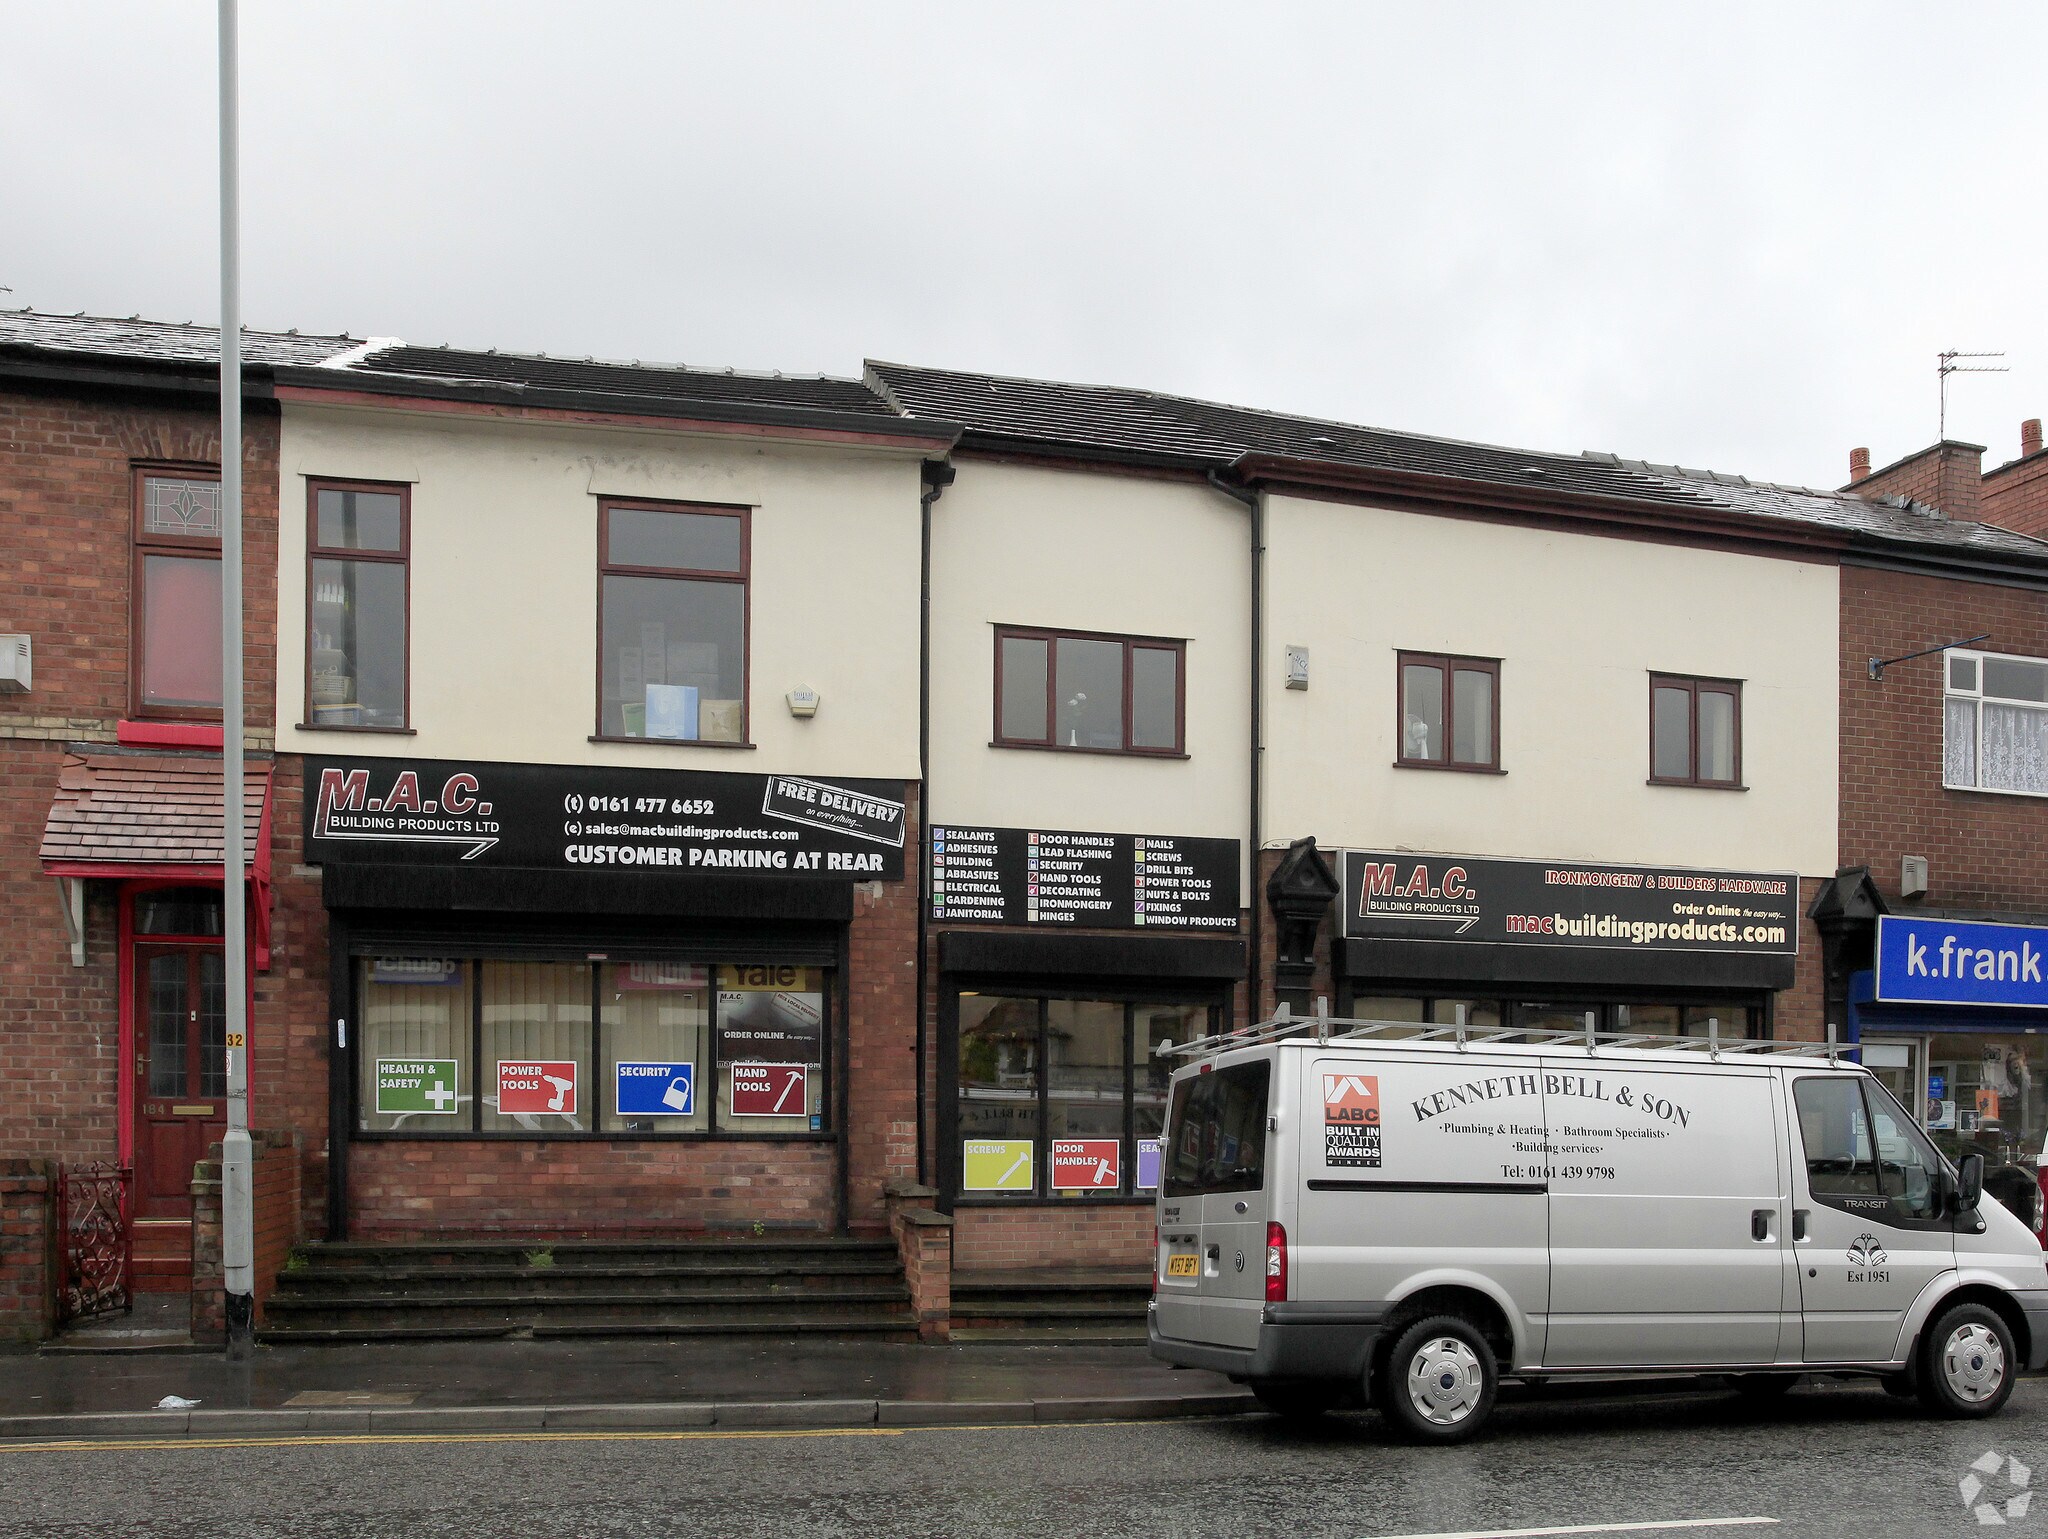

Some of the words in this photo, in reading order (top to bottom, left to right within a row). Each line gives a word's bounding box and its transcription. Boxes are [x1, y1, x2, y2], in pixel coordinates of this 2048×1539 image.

[313, 768, 493, 820] M.A.C.
[564, 793, 584, 814] (t)
[588, 796, 629, 812] 0161
[635, 798, 667, 813] 477
[671, 799, 714, 815] 6652
[777, 781, 817, 803] FREE
[820, 792, 899, 823] DELIVERY
[805, 808, 816, 816] on
[330, 816, 395, 830] BUILDING
[399, 818, 472, 832] PRODUCTS
[475, 821, 500, 834] LTD
[564, 822, 581, 836] (e)
[585, 823, 799, 841] sales@macbuildingproducts.com
[946, 830, 995, 842] SEALANTS
[1040, 835, 1069, 844] DOOR
[1071, 836, 1115, 846] HANDLES
[1146, 839, 1174, 849] NAILS
[946, 844, 998, 855] ADHESIVES
[1040, 847, 1064, 857] LEAD
[1066, 849, 1112, 859] FLASHING
[565, 845, 683, 866] CUSTOMER
[689, 848, 788, 869] PARKING
[793, 851, 822, 870] AT
[828, 852, 884, 872] REAR
[946, 857, 993, 867] BUILDING
[1146, 852, 1182, 862] SCREWS
[1040, 860, 1083, 870] SECURITY
[1146, 865, 1172, 875] DRILL
[1174, 866, 1194, 875] BITS
[946, 869, 999, 880] ABRASIVES
[1040, 873, 1068, 883] HAND
[1070, 875, 1101, 884] TOOLS
[946, 882, 1002, 893] ELECTRICAL
[1146, 878, 1179, 887] POWER
[1181, 879, 1212, 888] TOOLS
[1359, 863, 1476, 901] M.A.C.
[1545, 870, 1643, 888] IRONMONGERY
[1646, 875, 1656, 889] &
[1658, 876, 1716, 892] BUILDERS
[1719, 879, 1787, 895] HARDWARE
[1040, 886, 1101, 897] DECORATING
[1146, 890, 1170, 899] NUTS
[1172, 891, 1179, 899] &
[1181, 891, 1210, 901] BOLTS
[946, 895, 1005, 906] GARDENING
[1040, 899, 1112, 910] IRONMONGERY
[1146, 903, 1182, 913] FIXINGS
[1370, 901, 1412, 912] BUILDING
[1414, 902, 1462, 914] PRODUCTS
[1464, 904, 1480, 914] LTD
[1672, 902, 1704, 916] Order
[1707, 904, 1741, 917] Online
[1742, 908, 1753, 917] the
[1753, 911, 1768, 920] easy
[945, 908, 1004, 919] JANITORIAL
[1040, 912, 1075, 921] HINGES
[1146, 915, 1187, 925] WINDOW
[1190, 917, 1237, 927] PRODUCTS
[1506, 913, 1786, 944] macbuildingproducts.com
[1907, 933, 2042, 983] k.frank
[733, 963, 797, 986] Yale
[227, 1034, 243, 1047] 32
[724, 1031, 752, 1039] ORDER
[380, 1064, 425, 1075] HEALTH
[427, 1064, 436, 1074] &
[501, 1066, 543, 1076] POWER
[619, 1067, 671, 1077] SECURITY
[735, 1068, 768, 1078] HAND
[380, 1078, 422, 1089] SAFETY
[501, 1080, 539, 1090] TOOLS
[734, 1082, 771, 1092] TOOLS
[1411, 1075, 1538, 1122] KENNETH
[1545, 1075, 1610, 1101] BELL
[1615, 1086, 1634, 1107] &
[1641, 1093, 1691, 1129] SON
[1326, 1107, 1379, 1122] LABC
[1326, 1126, 1362, 1136] BUILT
[1366, 1127, 1379, 1136] IN
[1444, 1123, 1494, 1136] Plumbing
[1497, 1124, 1506, 1134] &
[1510, 1125, 1549, 1138] Heating
[1564, 1126, 1612, 1137] Bathroom
[1615, 1127, 1665, 1140] Specialists
[1326, 1135, 1380, 1147] QUALITY
[967, 1145, 1006, 1154] SCREWS
[1055, 1145, 1084, 1153] DOOR
[1327, 1147, 1380, 1157] AWARDS
[1561, 1143, 1600, 1153] services
[1055, 1157, 1098, 1166] HANDLES
[1501, 1165, 1524, 1178] Tel:
[1529, 1165, 1556, 1178] 0161
[1561, 1166, 1582, 1179] 439
[1587, 1167, 1615, 1179] 9798
[1844, 1199, 1888, 1209] TRANSIT
[1847, 1271, 1864, 1282] Est
[1867, 1271, 1890, 1282] 1951
